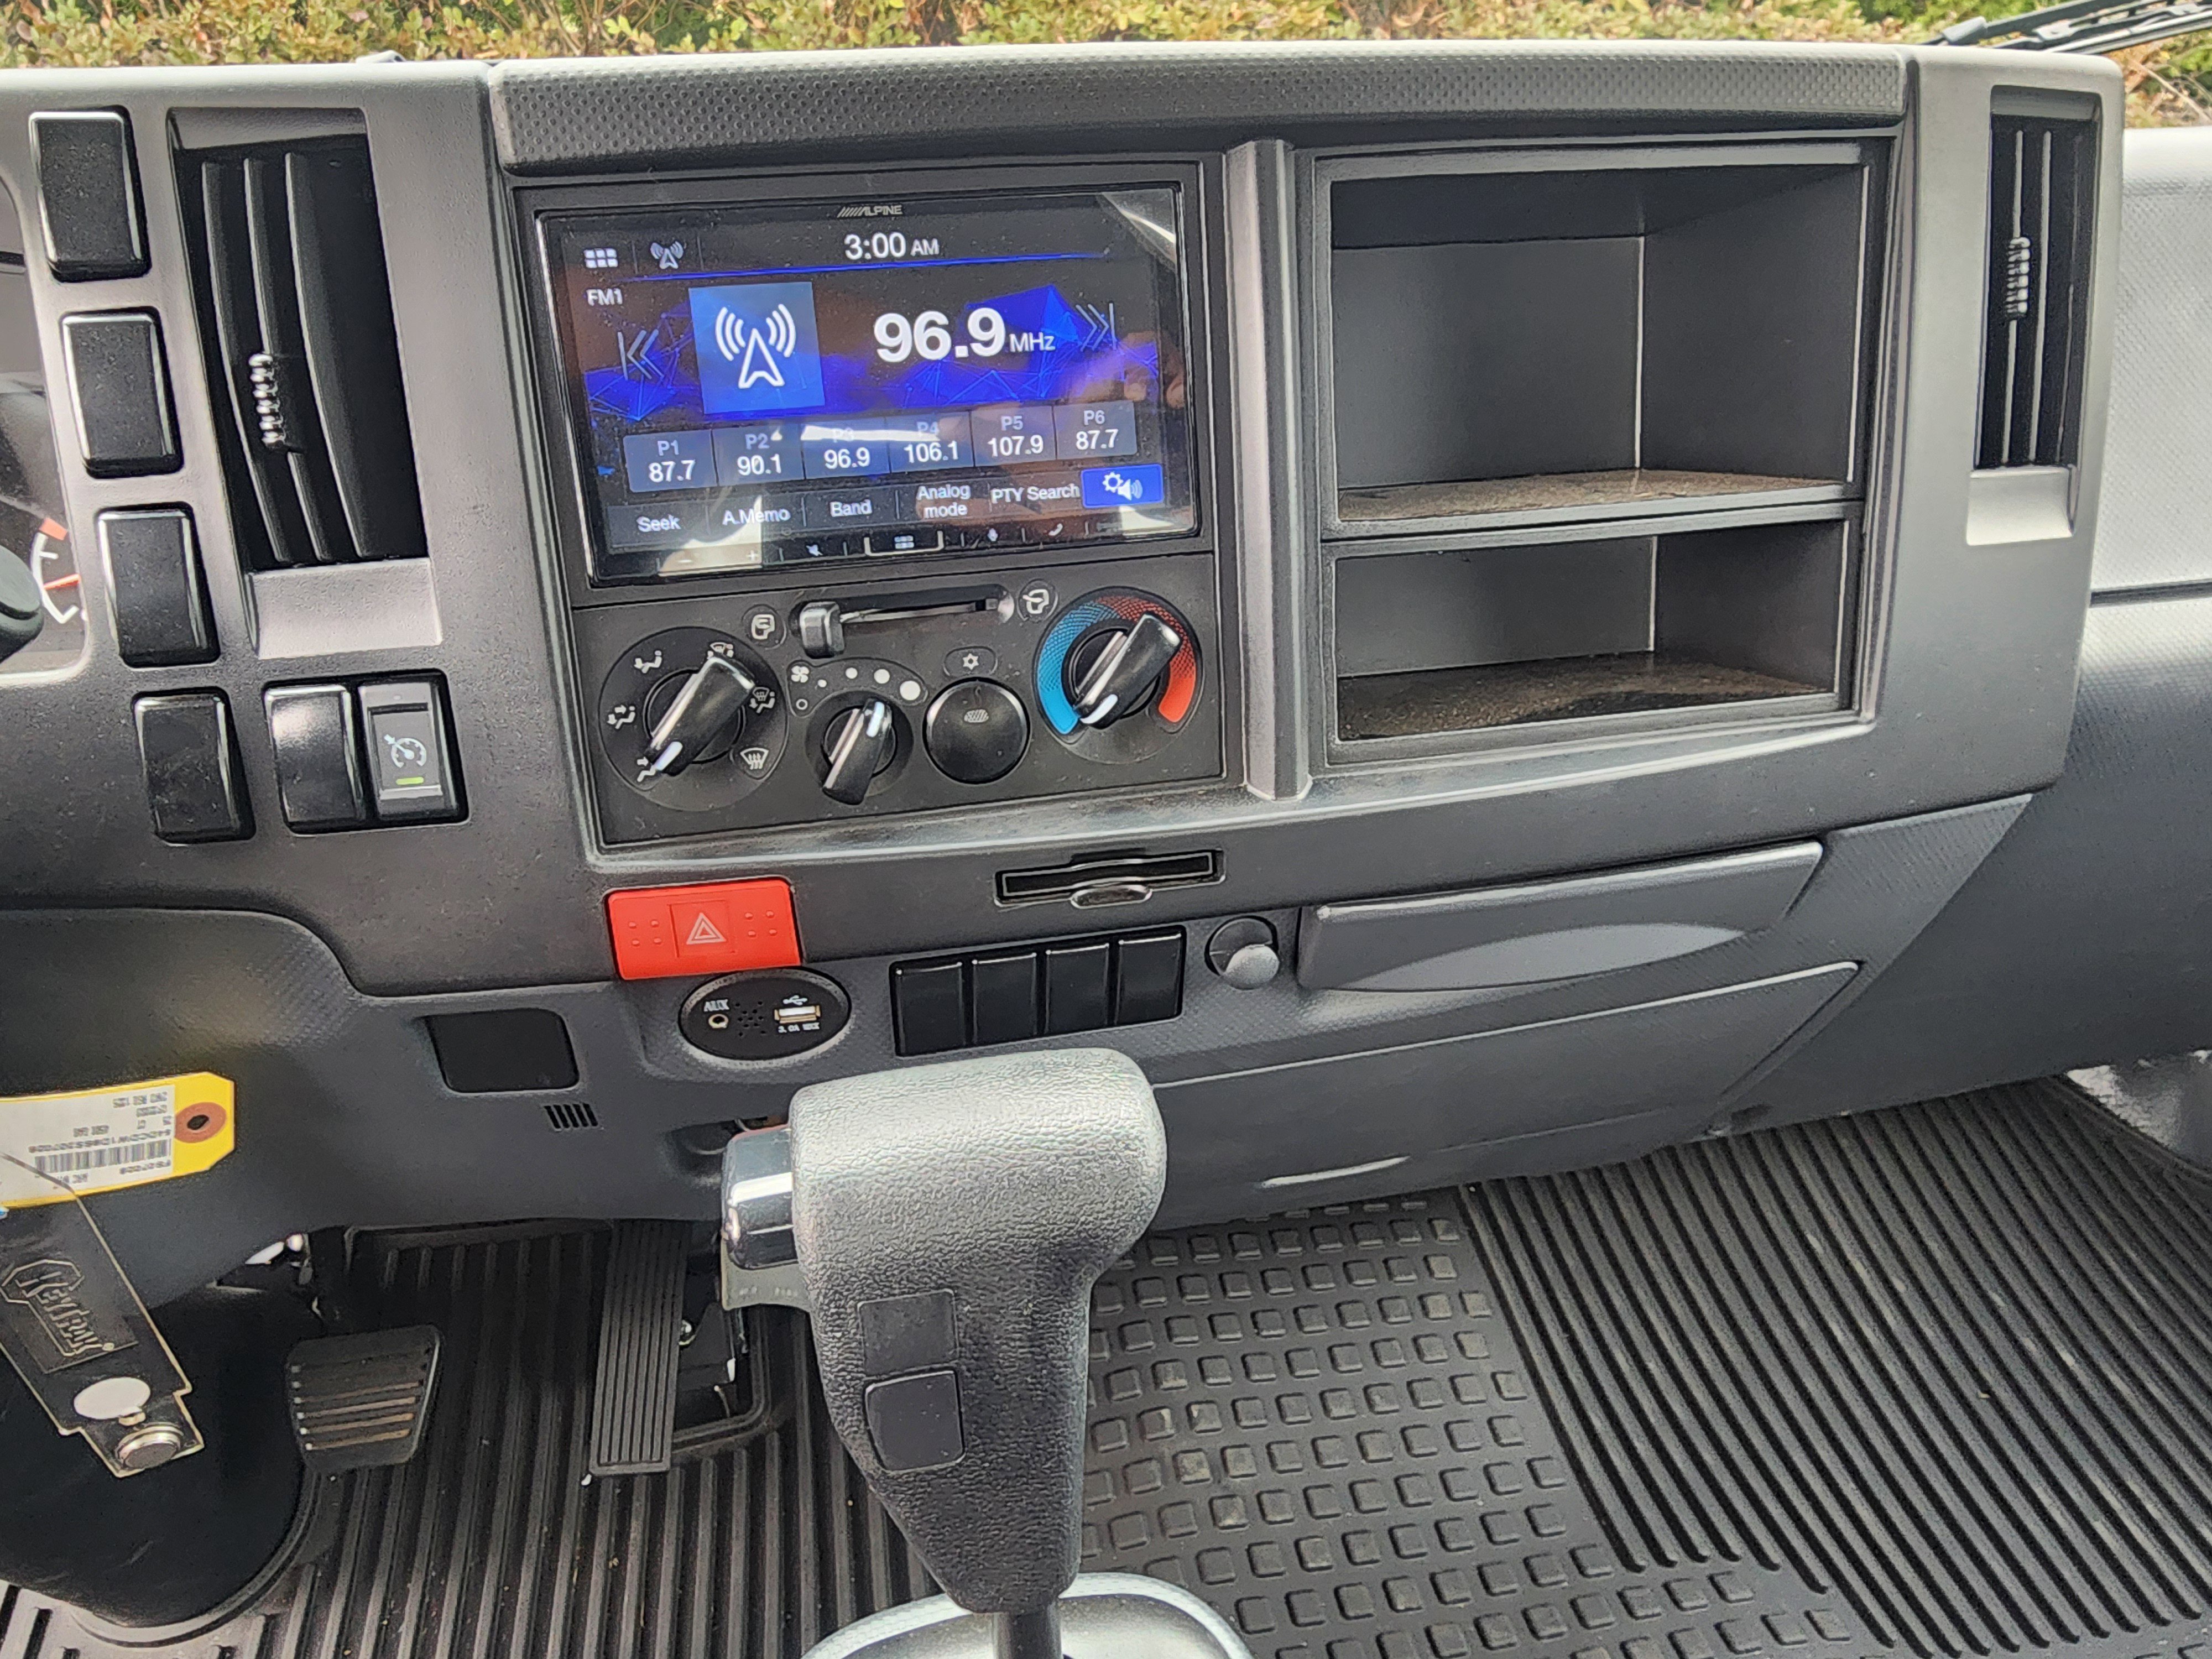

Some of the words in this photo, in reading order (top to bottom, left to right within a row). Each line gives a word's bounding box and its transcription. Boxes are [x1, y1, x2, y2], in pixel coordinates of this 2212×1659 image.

[844, 231, 906, 260] 3:00
[911, 238, 940, 257] AM
[586, 288, 623, 306] FM1
[874, 307, 1006, 363] 96.9
[1009, 332, 1056, 352] MHz
[1000, 415, 1023, 431] P5
[1083, 410, 1105, 426] P6
[917, 421, 939, 436] P4
[657, 440, 679, 457] P1
[745, 433, 770, 451] P2
[988, 434, 1044, 457] 107.9
[1076, 428, 1118, 451] 87.7
[823, 447, 870, 469] 96.9
[904, 441, 959, 463] 106.1
[649, 460, 696, 482] 87.7
[737, 453, 782, 476] 90.1
[916, 484, 971, 502] Analog
[991, 487, 1022, 504] PTY
[1027, 483, 1081, 500] Search
[722, 506, 791, 526] A.Memo
[830, 499, 873, 518] Band
[924, 501, 968, 518] mode
[637, 514, 681, 533] Seek
[703, 999, 730, 1012] AUX
